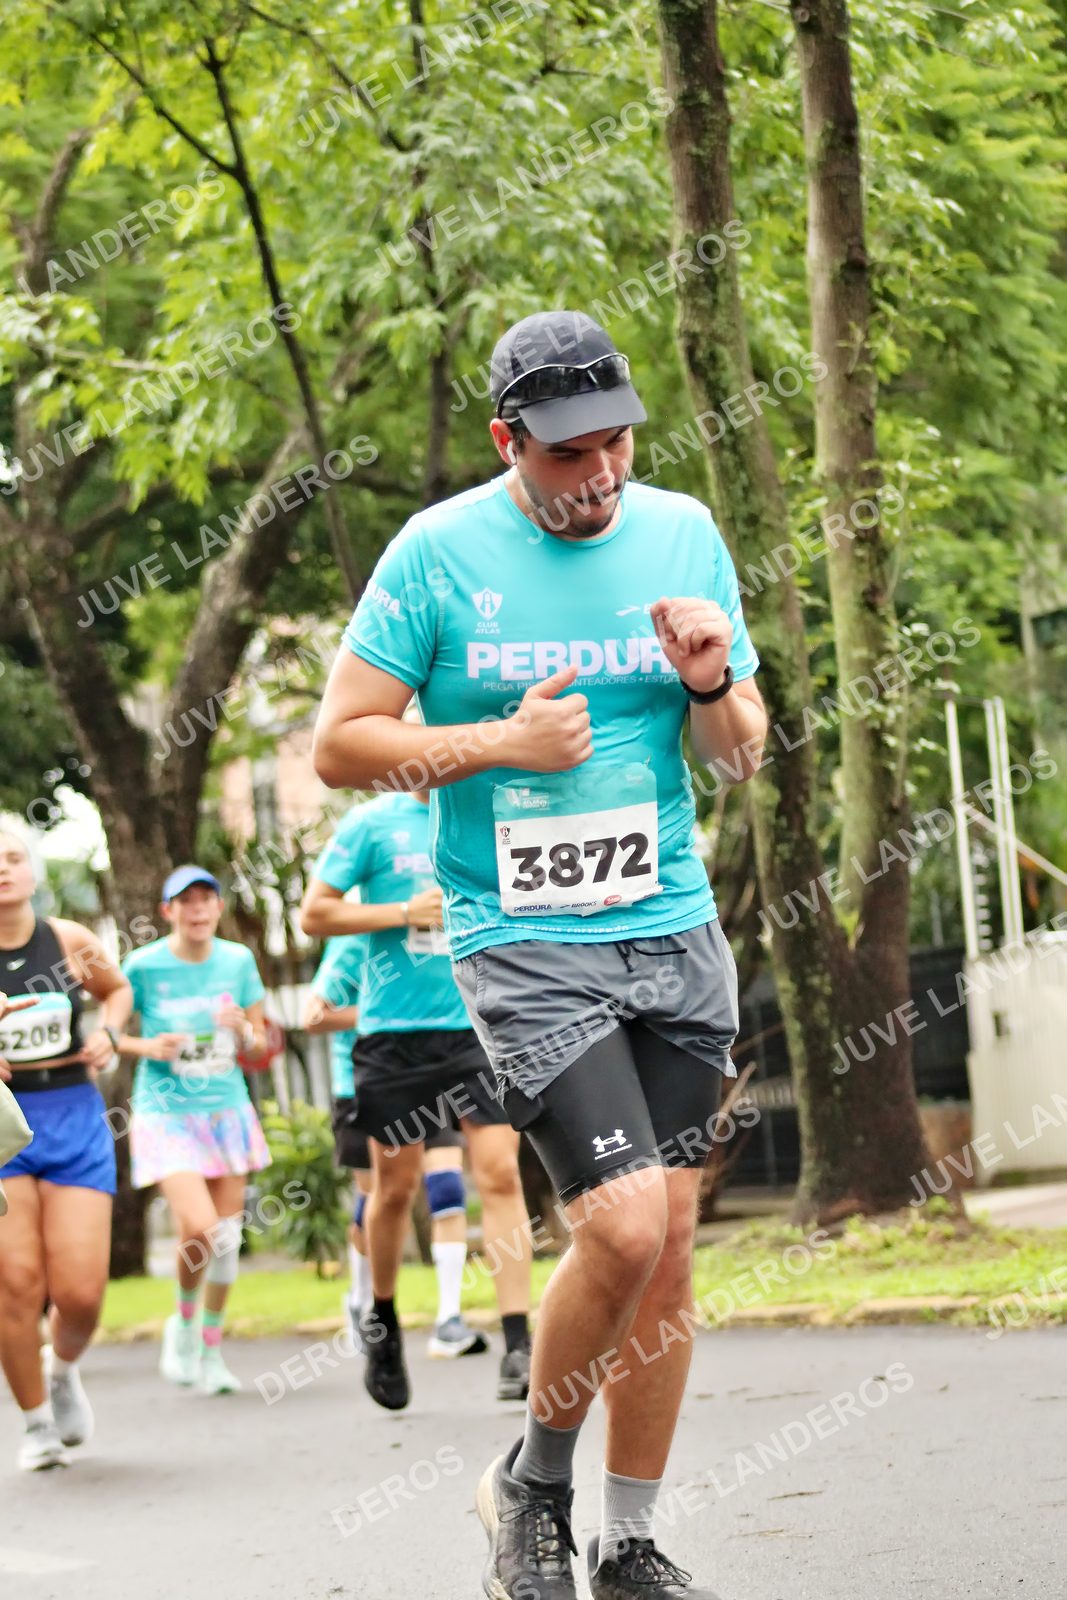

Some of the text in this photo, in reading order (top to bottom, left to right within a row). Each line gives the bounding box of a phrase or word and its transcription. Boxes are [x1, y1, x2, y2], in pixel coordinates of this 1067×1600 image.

[467, 636, 680, 681] PERDUR
[483, 681, 515, 691] PEGA
[510, 832, 651, 892] 3872
[513, 903, 552, 913] PERDURA
